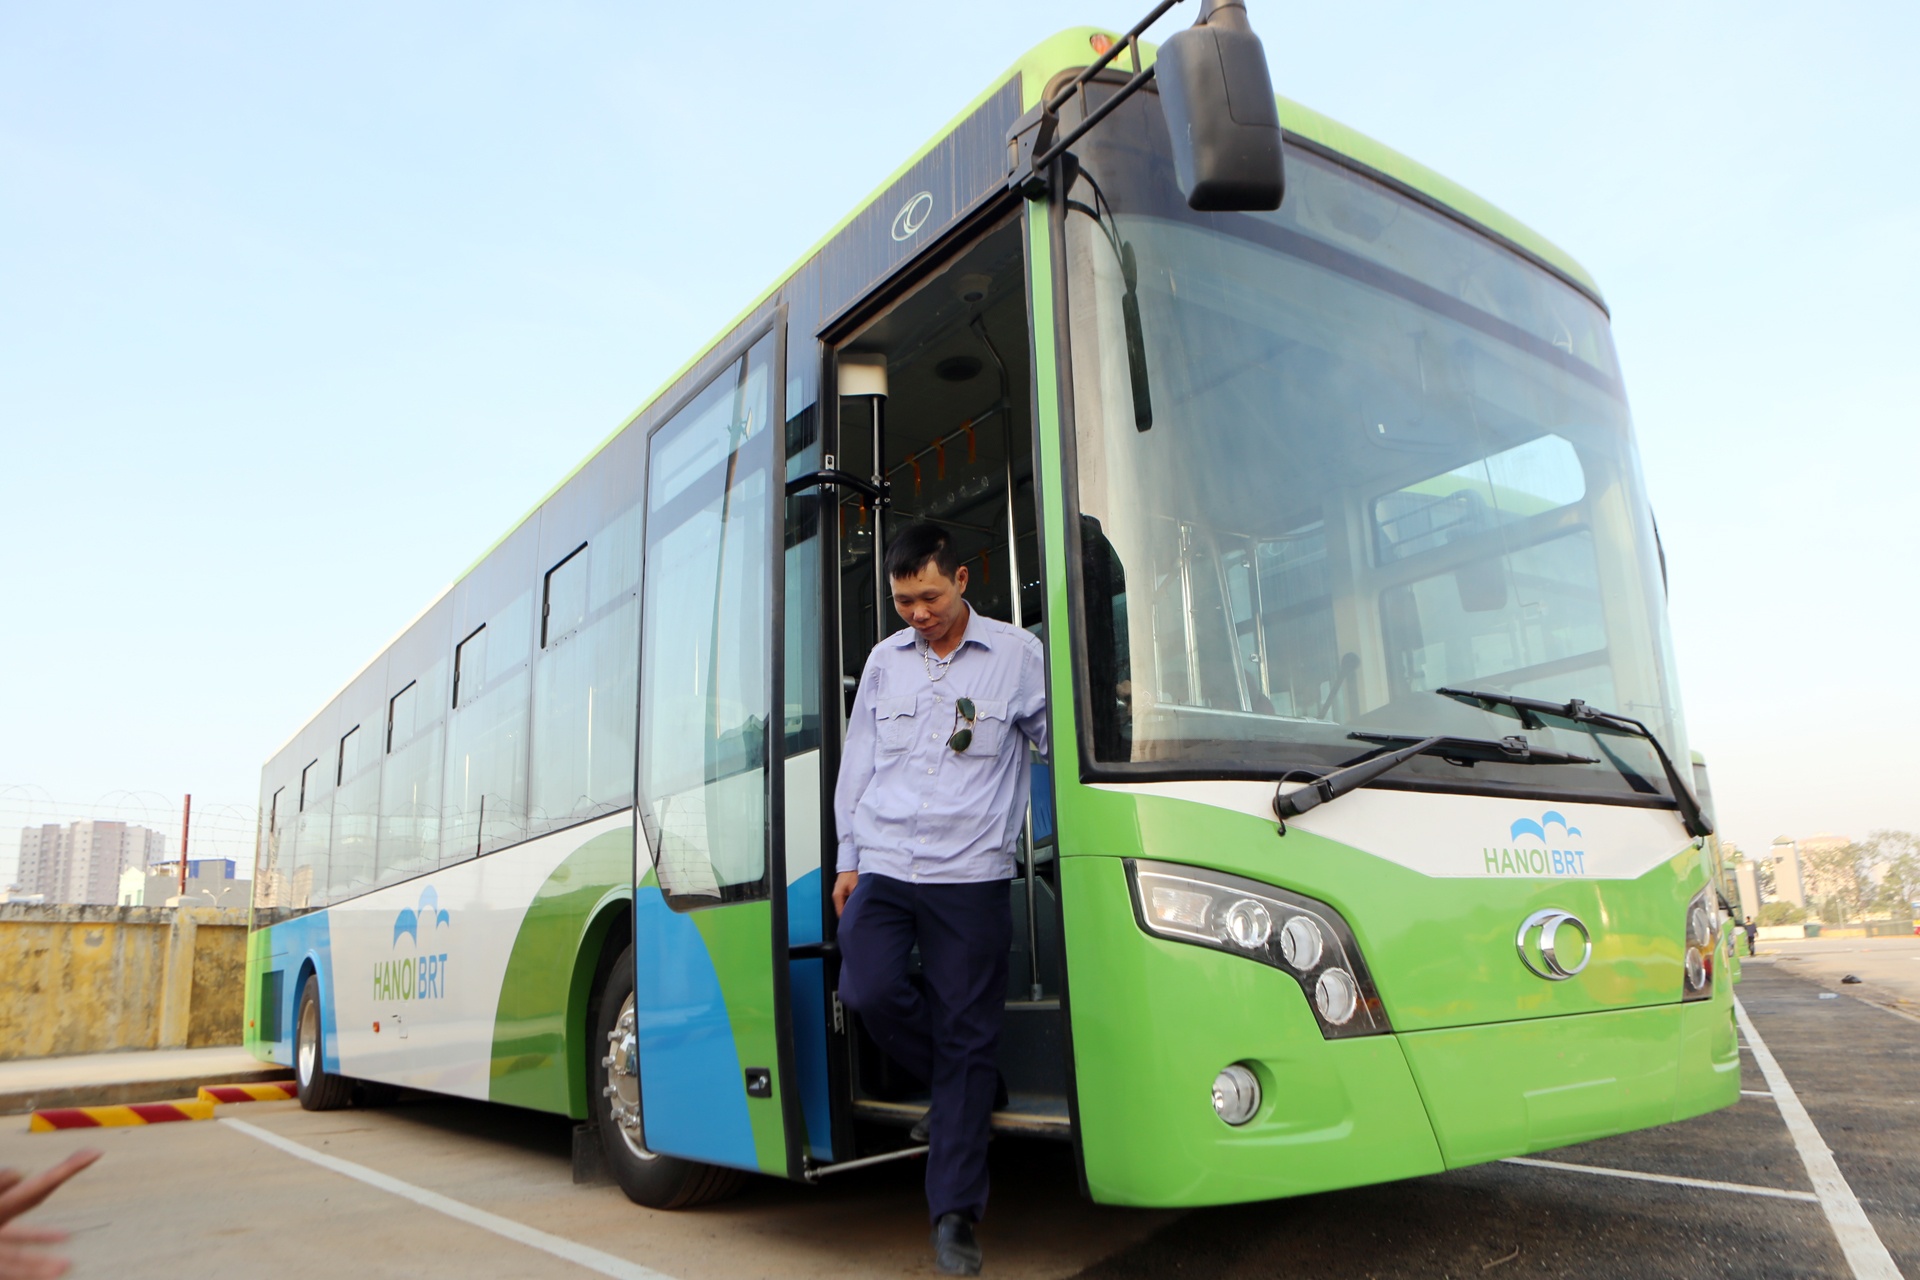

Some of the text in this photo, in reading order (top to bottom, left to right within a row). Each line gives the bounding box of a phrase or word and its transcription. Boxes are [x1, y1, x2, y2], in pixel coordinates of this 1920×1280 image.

[1483, 847, 1585, 875] HANOI BRT
[373, 953, 448, 1001] HANOI BRT
